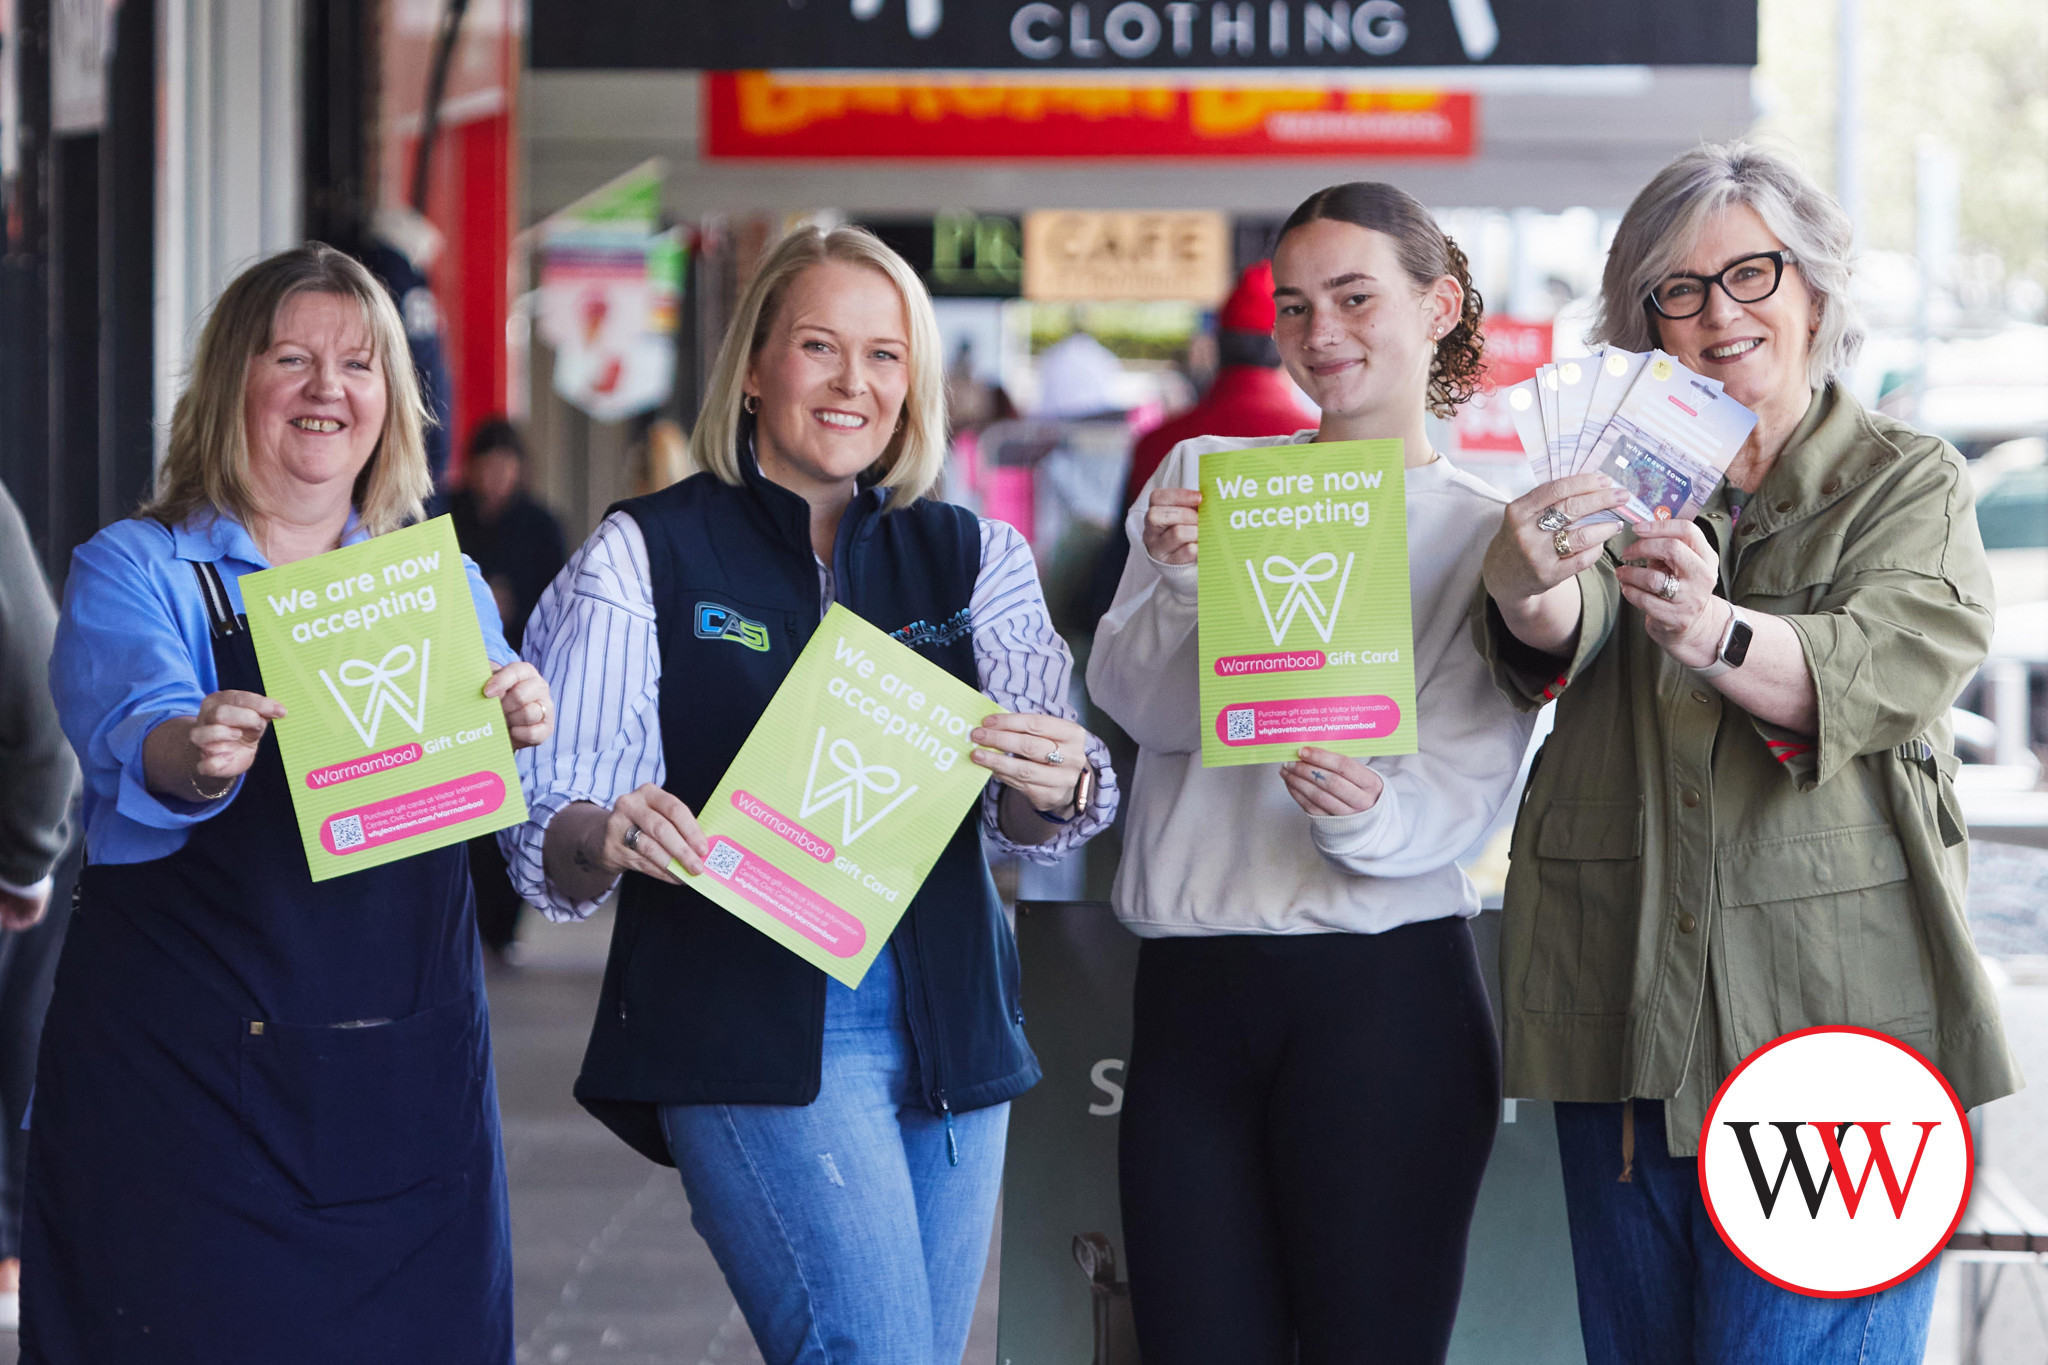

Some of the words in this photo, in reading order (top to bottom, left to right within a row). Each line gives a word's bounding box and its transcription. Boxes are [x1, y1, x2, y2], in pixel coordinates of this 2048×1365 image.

[1010, 0, 1408, 60] CLOTHING
[1047, 215, 1203, 262] CAFE
[1216, 475, 1258, 500] We
[1266, 474, 1314, 496] are
[1324, 470, 1383, 492] now
[1626, 443, 1643, 456] why
[1644, 454, 1665, 471] leave
[1667, 470, 1687, 486] town
[1230, 498, 1370, 530] accepting
[267, 588, 317, 616] We
[326, 573, 374, 602] are
[383, 551, 439, 585] now
[292, 585, 436, 642] accepting
[701, 608, 770, 651] CAS
[834, 636, 875, 678] We
[880, 673, 926, 711] are
[1220, 653, 1319, 672] Warrnambool
[1328, 652, 1356, 666] Gift
[1361, 649, 1399, 664] Card
[828, 677, 959, 771] accepting
[1258, 710, 1287, 718] Purchase
[1288, 708, 1299, 716] gift
[1351, 704, 1390, 712] Information
[1330, 714, 1350, 722] online
[312, 745, 417, 785] Warrnambool
[424, 736, 453, 754] Gift
[456, 722, 493, 744] Card
[363, 809, 394, 821] Purchase
[395, 804, 406, 814] gift
[407, 799, 426, 809] cards
[435, 790, 455, 801] Visitor
[456, 779, 494, 795] Information
[390, 814, 406, 824] Civic
[406, 807, 428, 818] Centre
[438, 799, 458, 809] online
[738, 793, 831, 860] Warrnambool
[834, 856, 862, 880] Gift
[862, 874, 898, 902] Card
